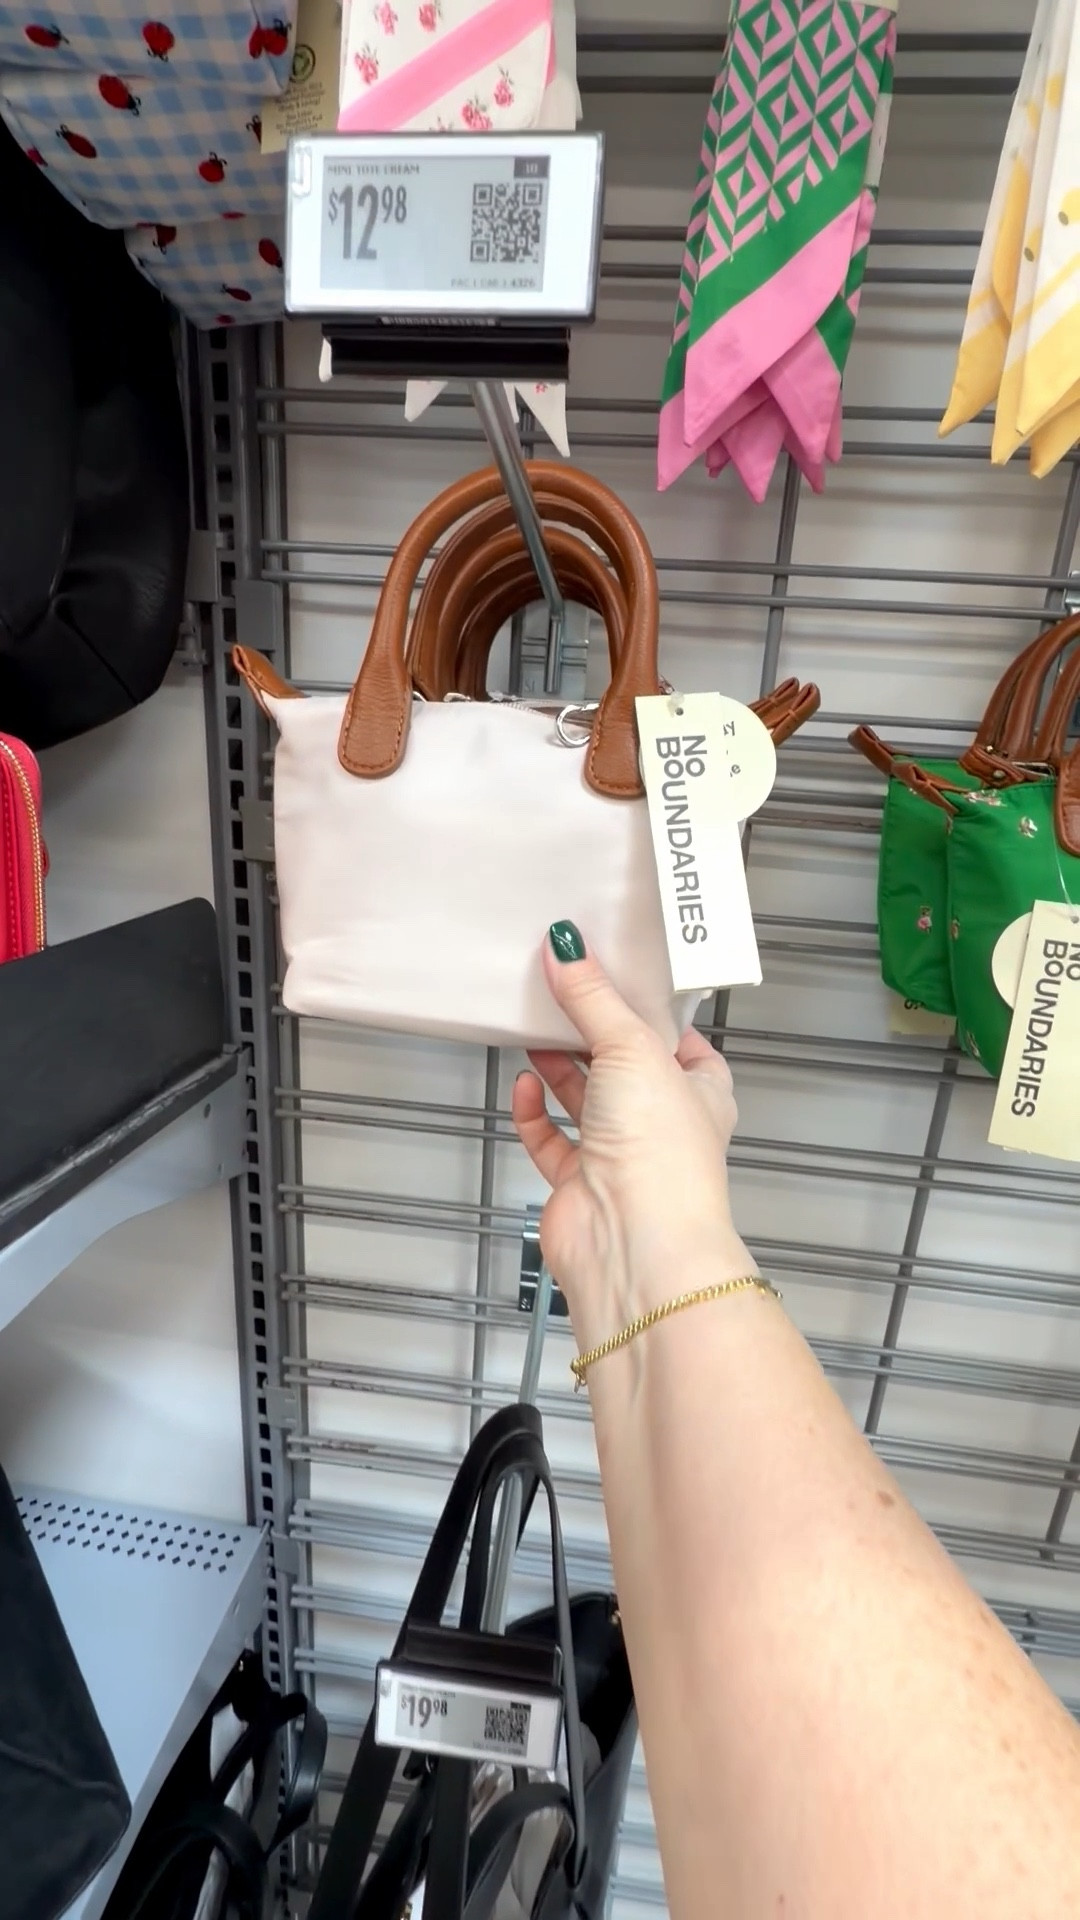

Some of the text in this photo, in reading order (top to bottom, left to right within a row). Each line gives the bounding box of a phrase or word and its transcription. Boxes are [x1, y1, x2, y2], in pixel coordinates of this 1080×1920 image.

[656, 736, 708, 944] BOUNDARIES
[682, 734, 708, 777] NO
[1011, 939, 1069, 1118] BOUNDARIES
